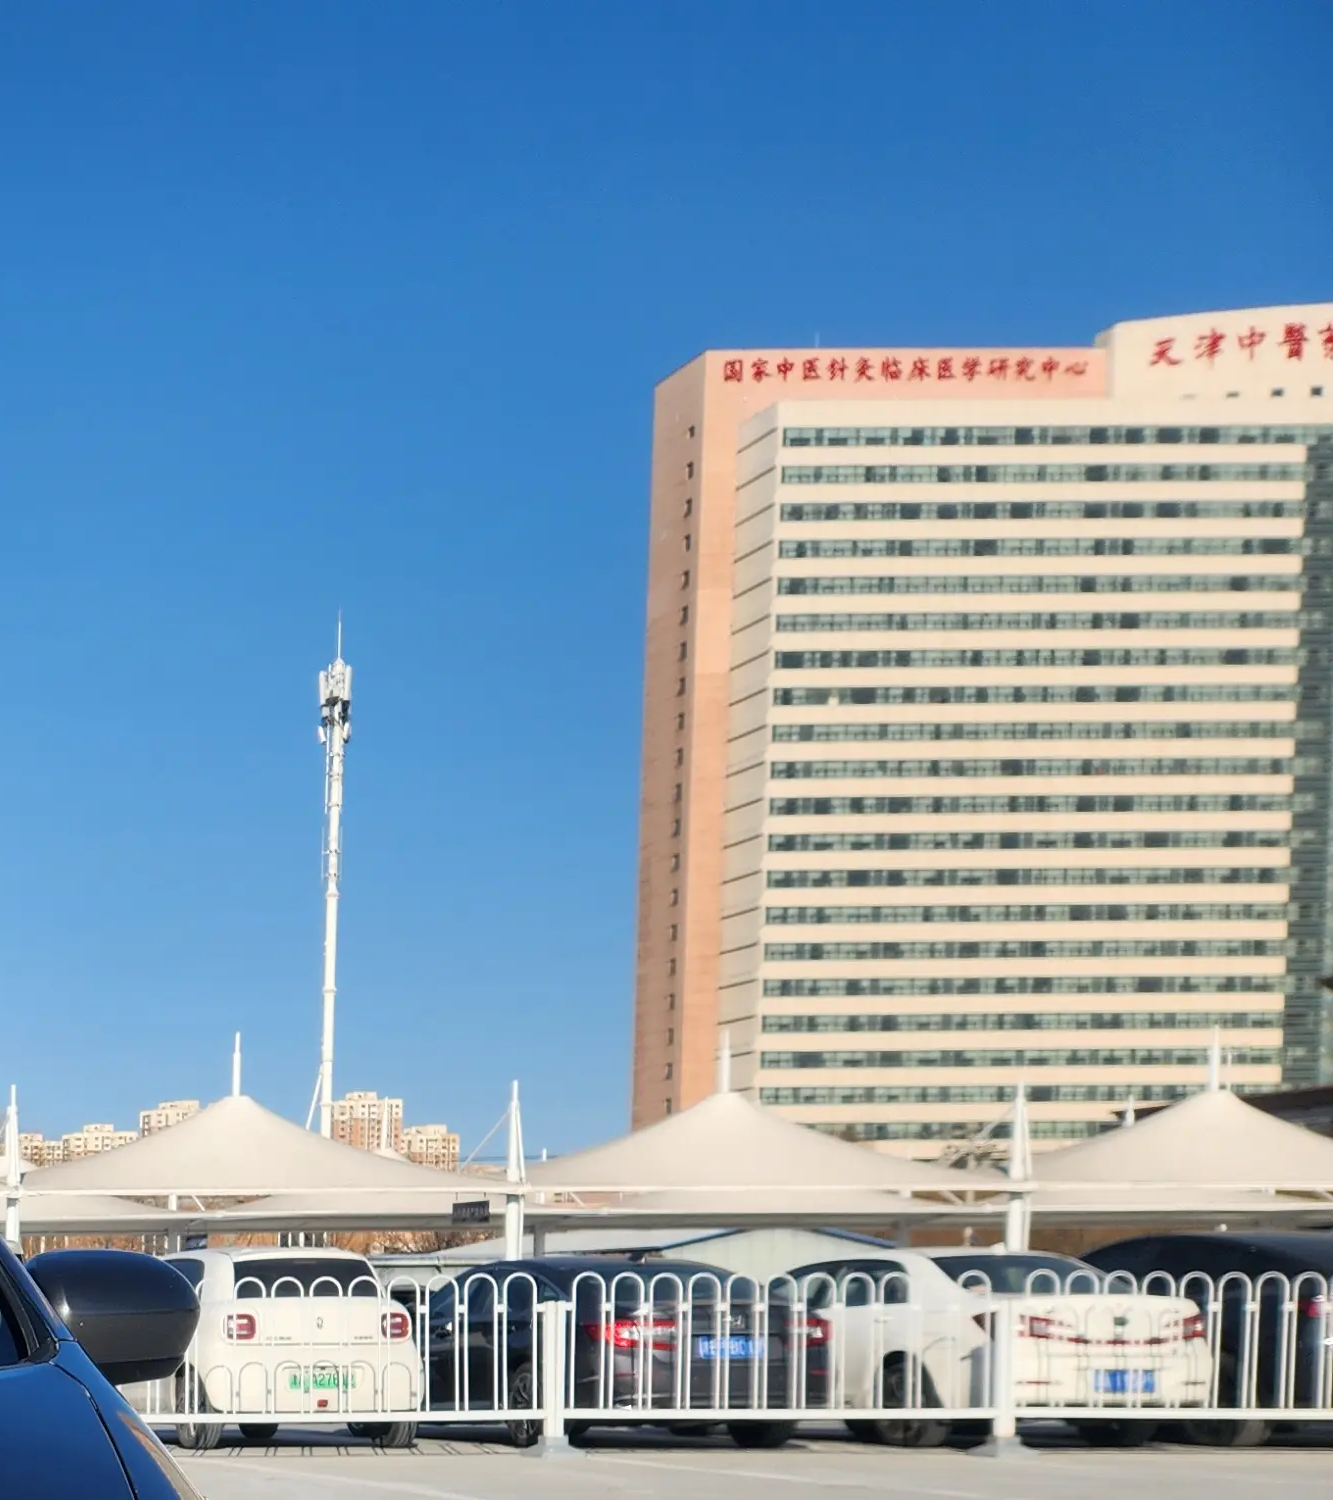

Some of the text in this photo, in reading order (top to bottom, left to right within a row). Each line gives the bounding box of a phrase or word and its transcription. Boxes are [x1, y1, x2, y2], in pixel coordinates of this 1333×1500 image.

[723, 355, 1089, 383] 国家中医针灸临床医学研究中心
